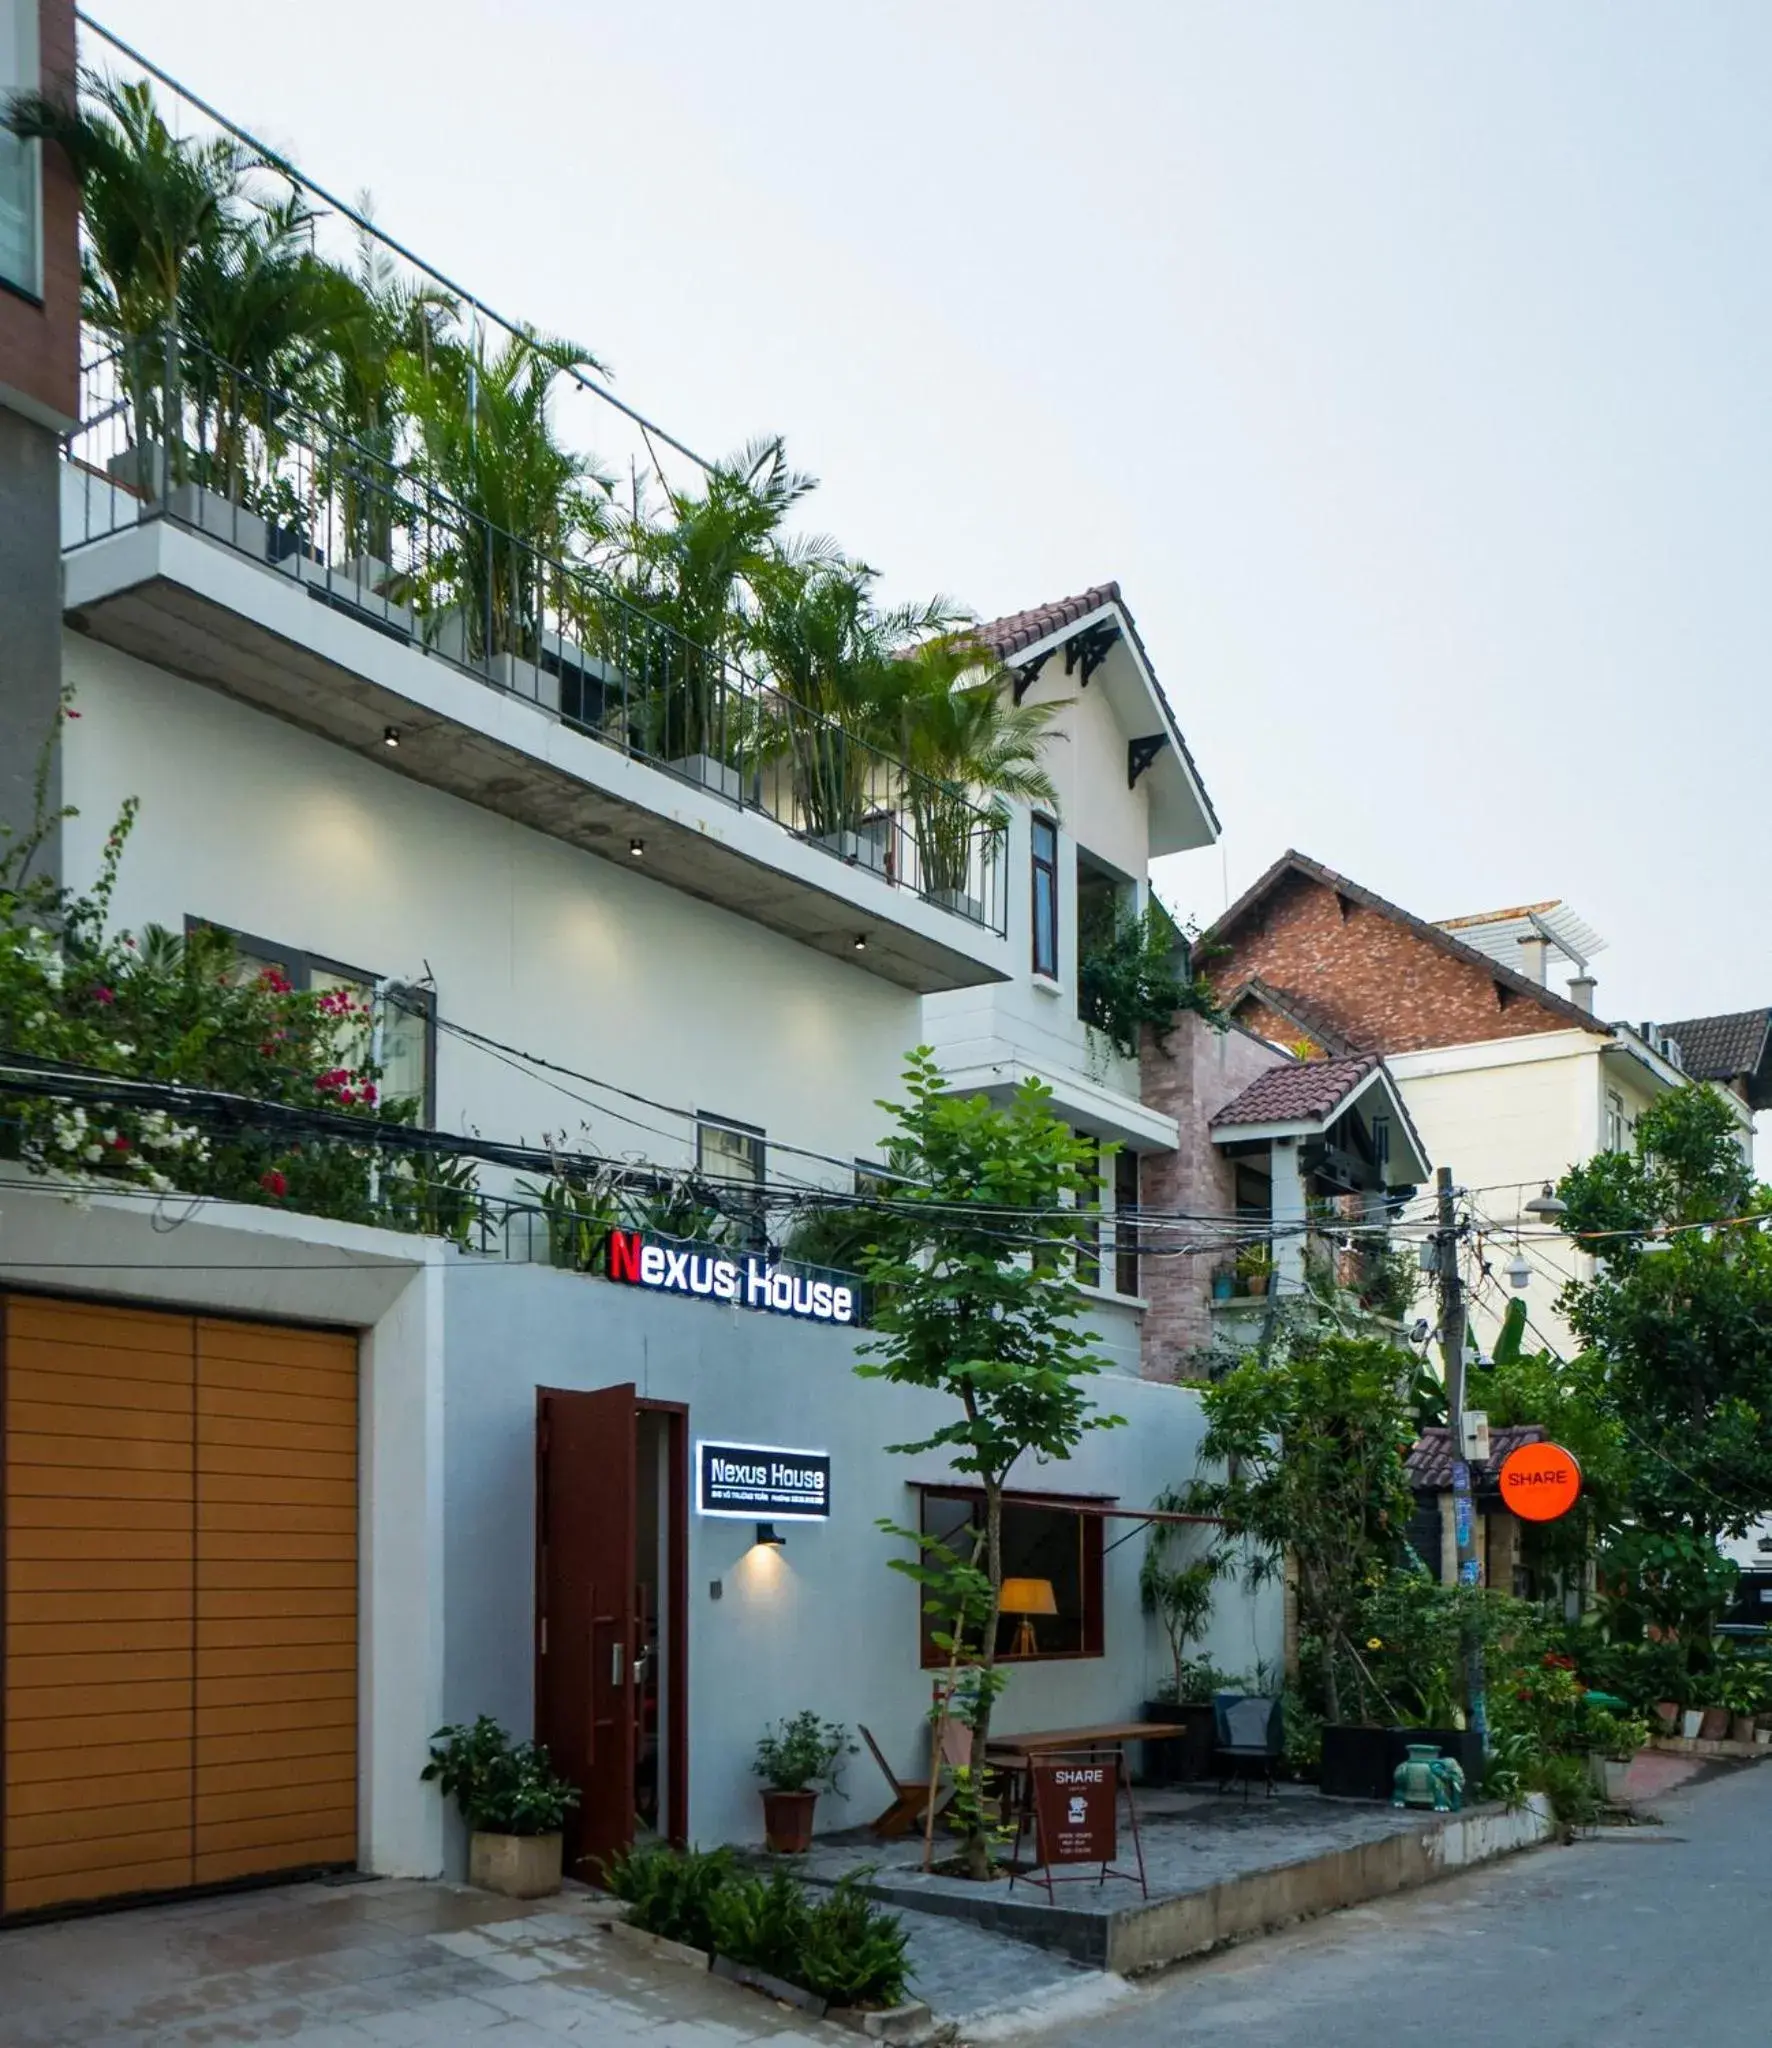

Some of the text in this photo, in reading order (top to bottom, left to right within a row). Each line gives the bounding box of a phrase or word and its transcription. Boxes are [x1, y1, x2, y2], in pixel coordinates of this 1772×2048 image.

[610, 1230, 852, 1321] Nexus House
[711, 1458, 825, 1489] Nexus House
[1508, 1470, 1568, 1487] SHARE
[1056, 1770, 1104, 1784] SHARE
